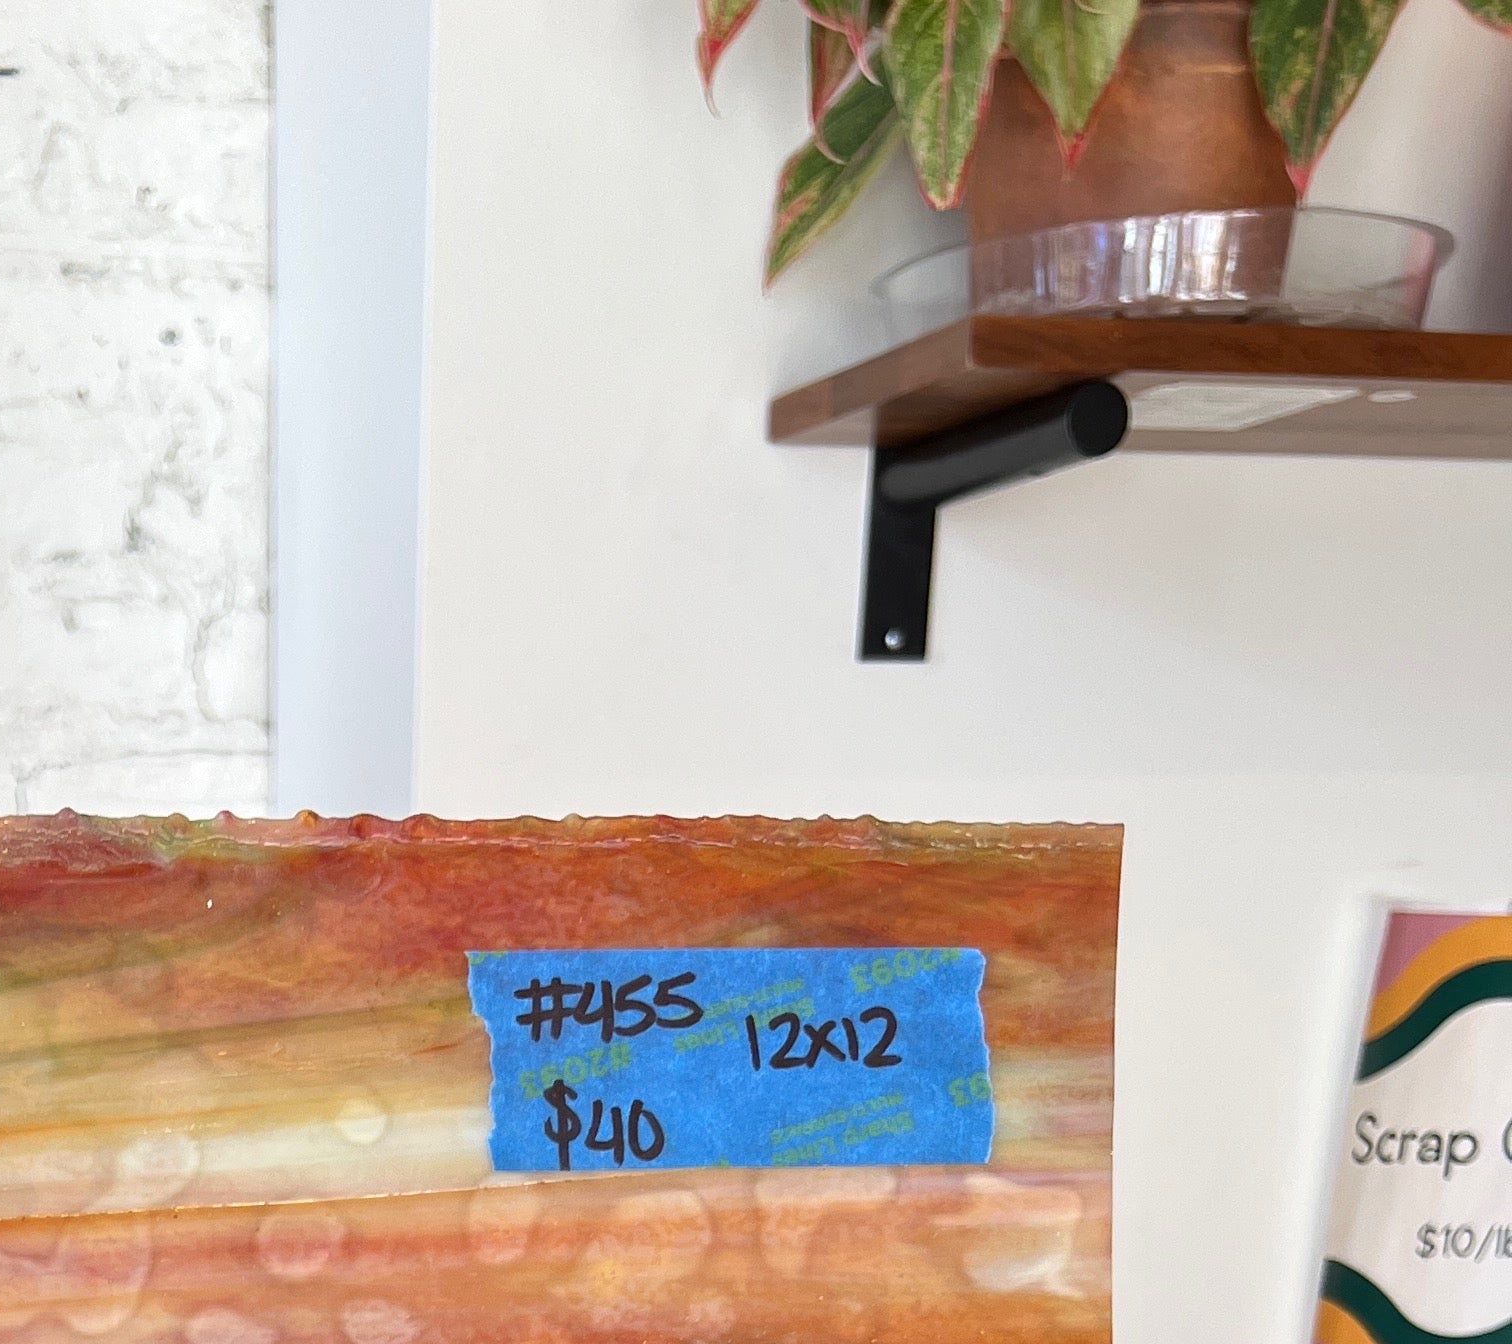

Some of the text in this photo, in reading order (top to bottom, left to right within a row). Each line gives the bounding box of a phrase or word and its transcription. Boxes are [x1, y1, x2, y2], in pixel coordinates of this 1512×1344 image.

[514, 971, 704, 1044] #455
[543, 1078, 665, 1170] $40
[1351, 1110, 1480, 1181] Scrap
